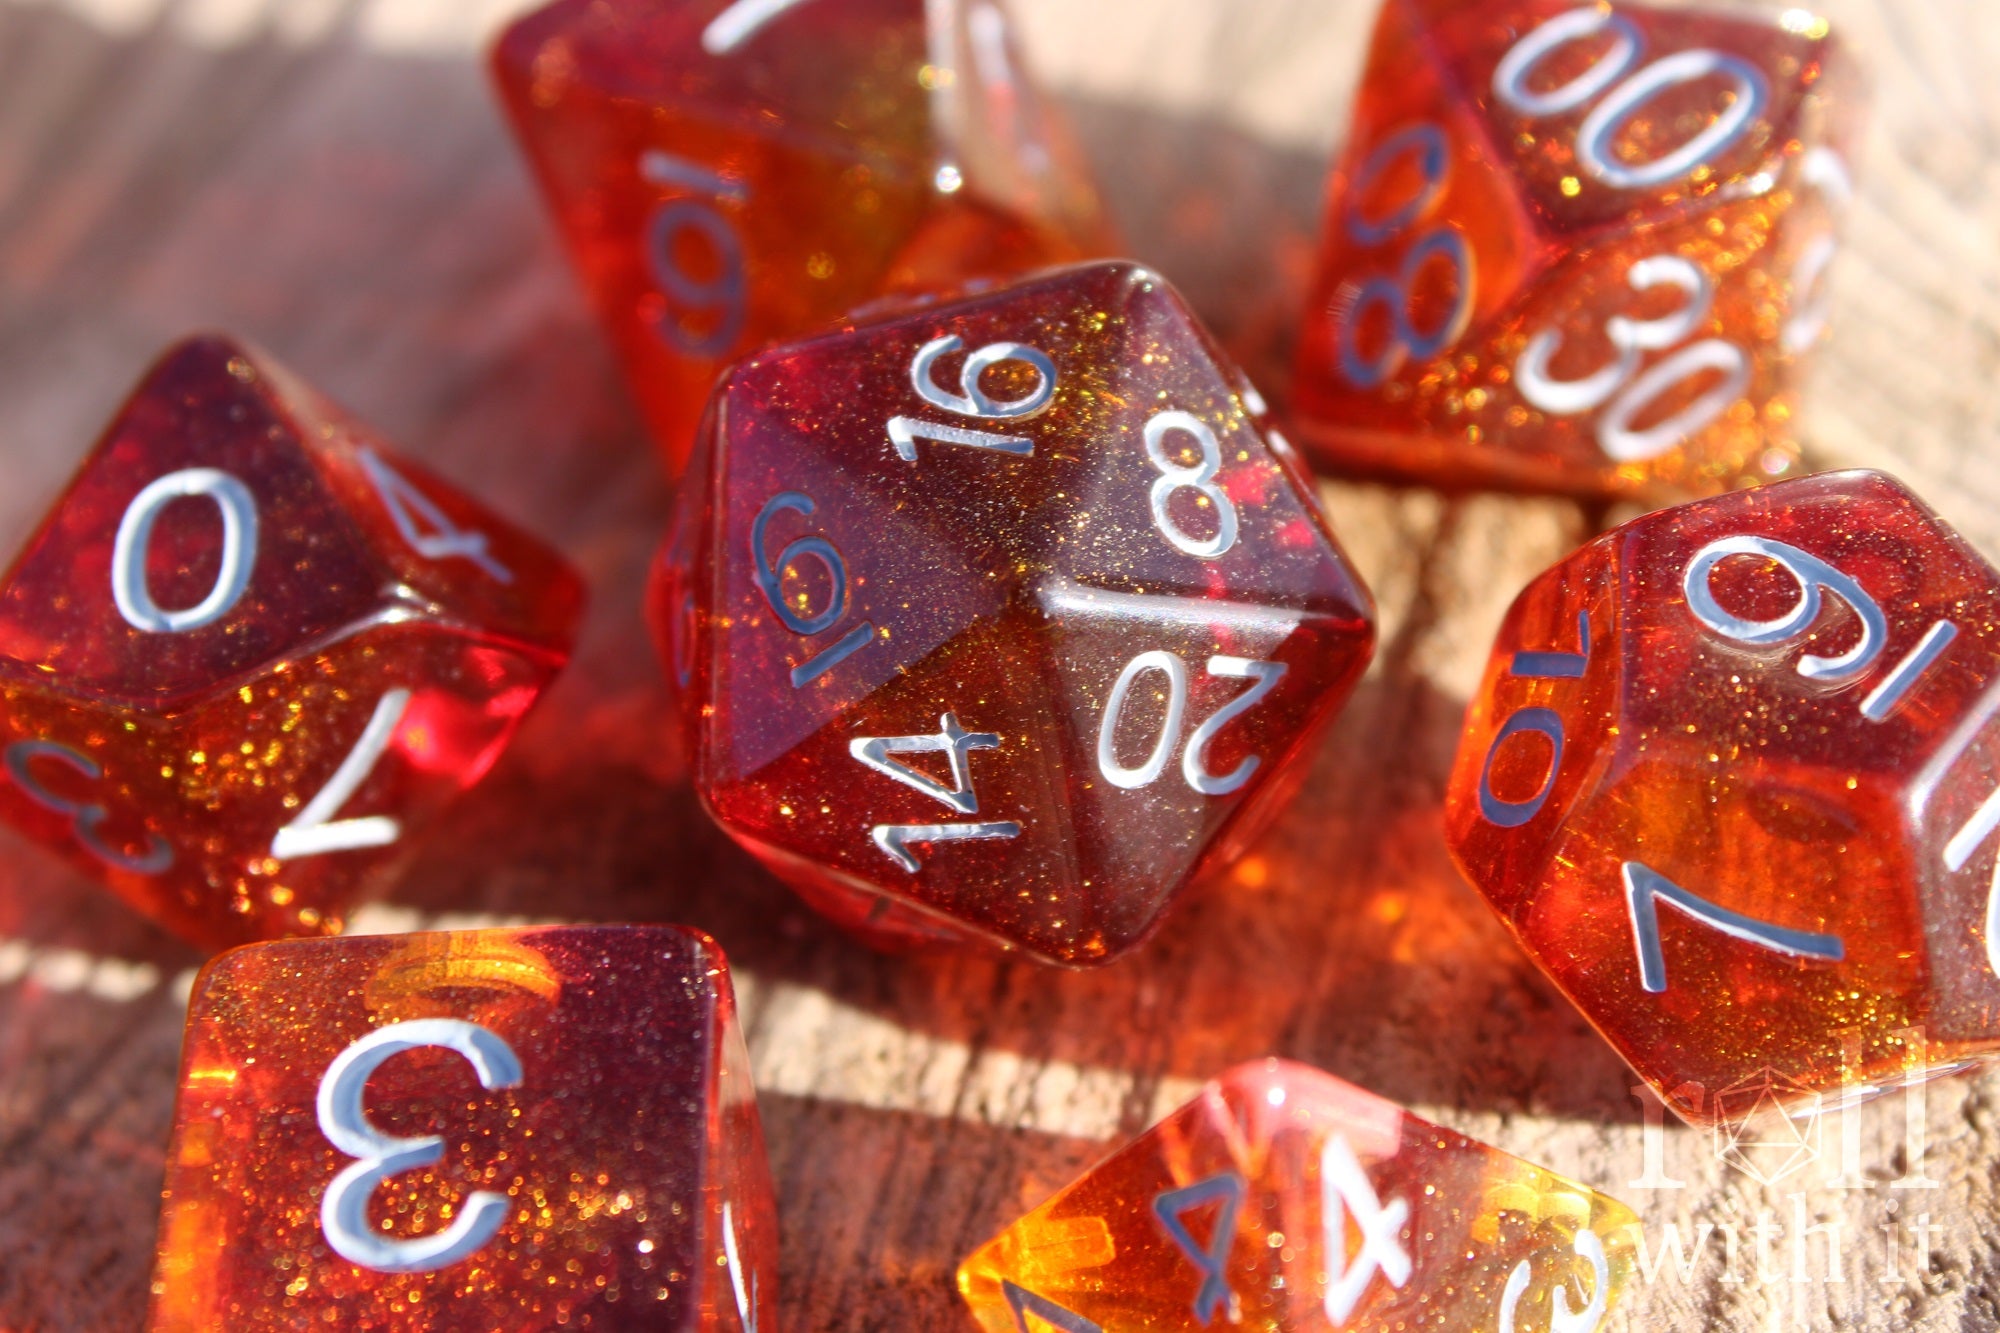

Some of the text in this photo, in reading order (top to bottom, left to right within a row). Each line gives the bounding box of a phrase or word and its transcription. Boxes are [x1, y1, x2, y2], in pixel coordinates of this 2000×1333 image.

[1492, 5, 1768, 187] 00
[886, 334, 1058, 462] 16
[1515, 253, 1752, 462] 30
[110, 467, 259, 634] 0
[358, 446, 516, 584] 4
[1143, 410, 1239, 561] 8
[849, 712, 1022, 874] 14
[1098, 649, 1288, 796] 20
[1479, 609, 1591, 828] 10
[3, 740, 174, 874] 3
[1622, 860, 1845, 993] 7
[316, 1017, 524, 1273] 3
[1154, 1171, 1247, 1327] 4
[1322, 1133, 1414, 1329] 4
